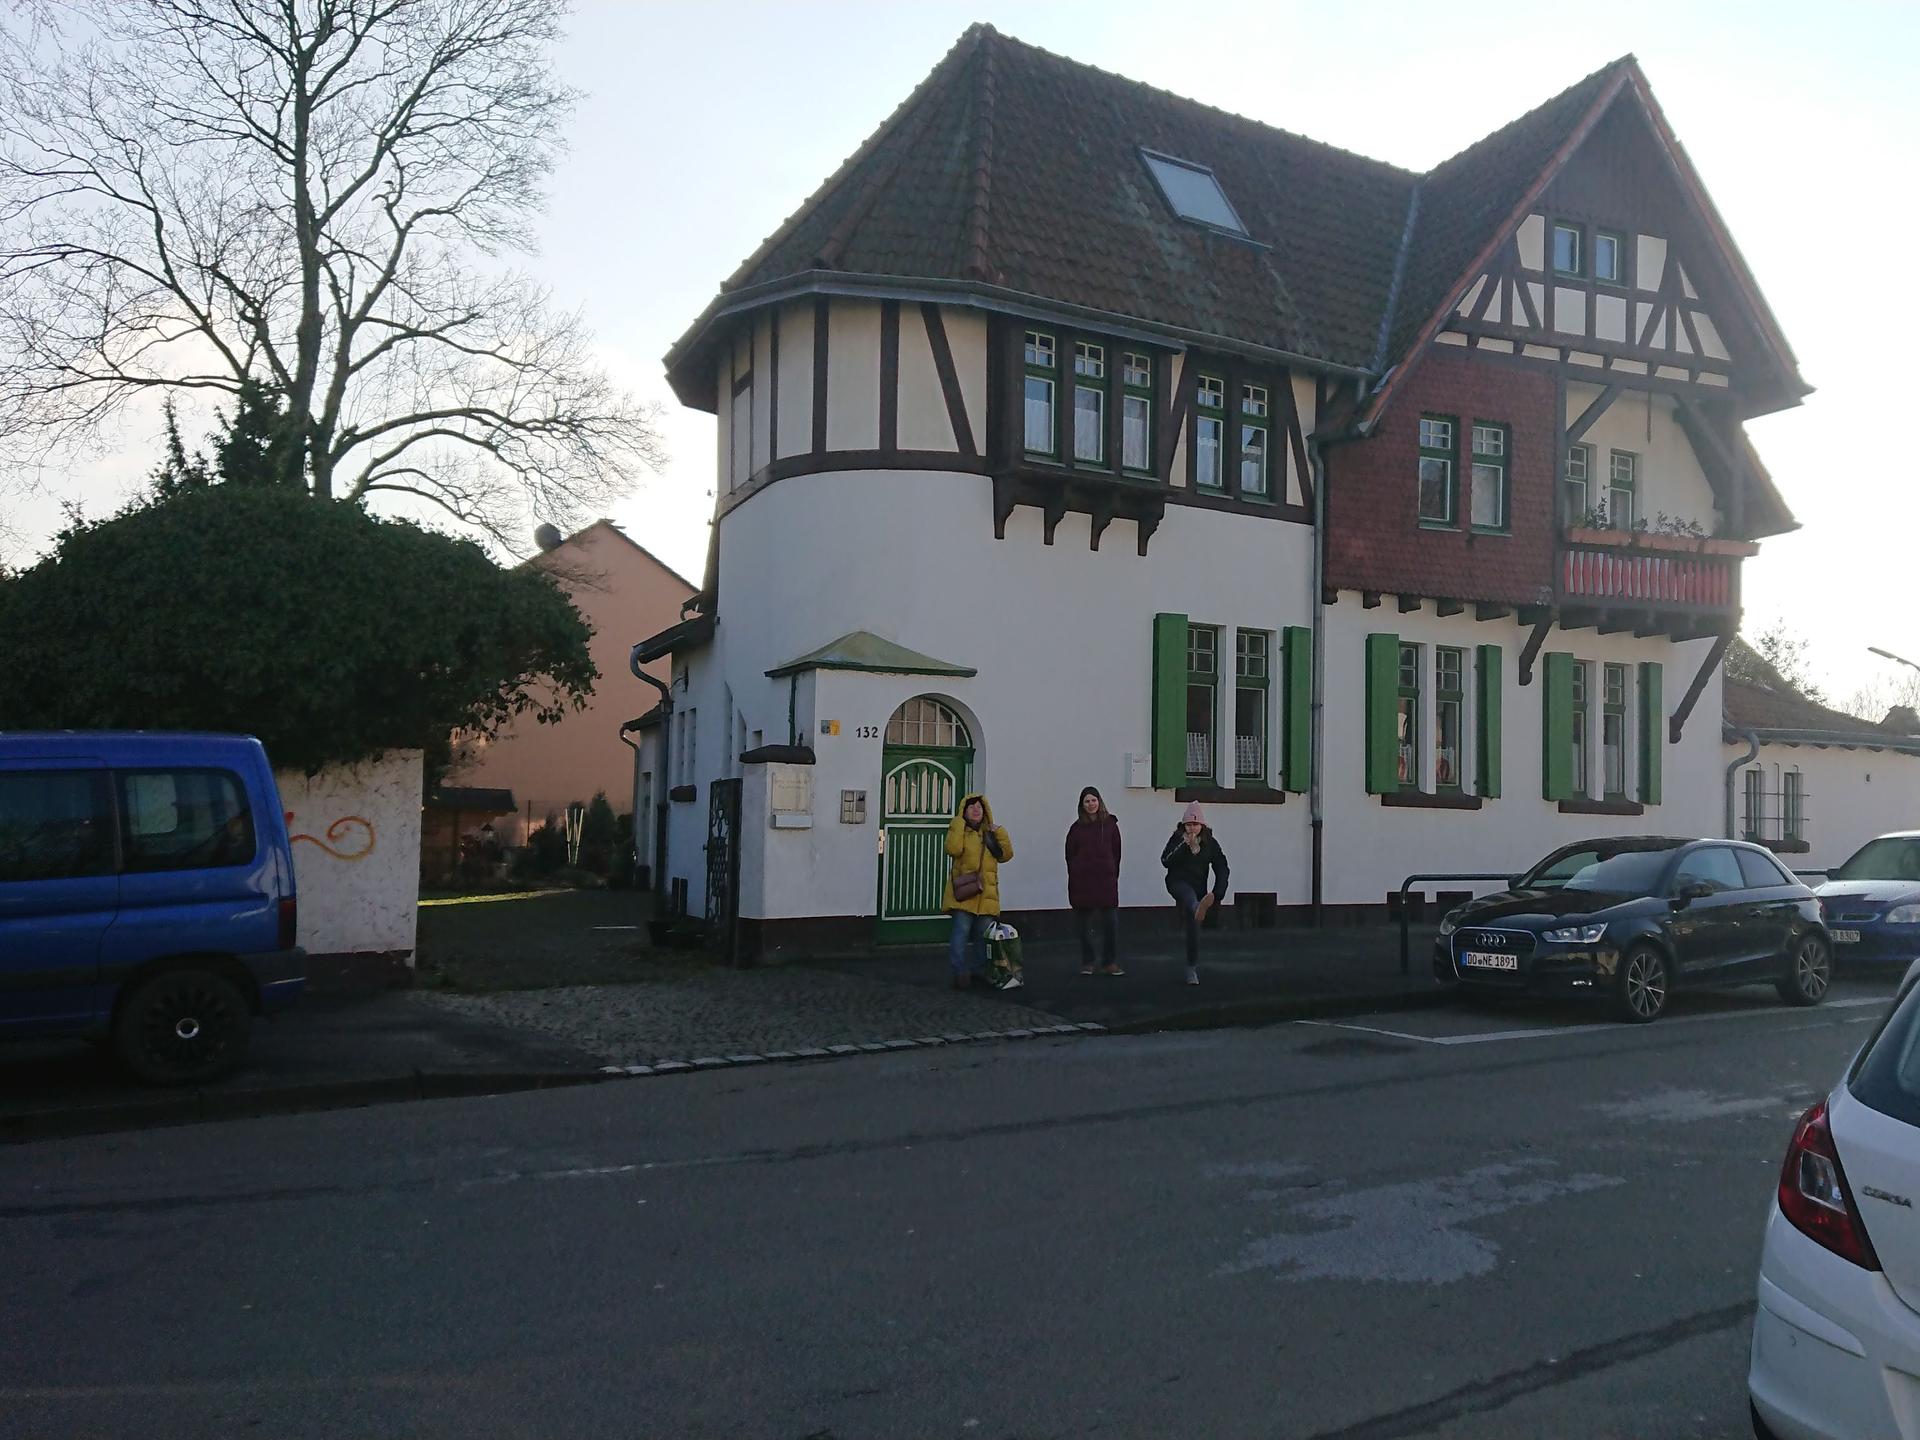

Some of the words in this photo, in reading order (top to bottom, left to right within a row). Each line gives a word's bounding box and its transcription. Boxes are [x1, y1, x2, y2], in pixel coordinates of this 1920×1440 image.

[855, 726, 879, 738] 132
[1467, 953, 1478, 965] DO
[1482, 954, 1493, 966] NE
[1495, 955, 1516, 968] 1891
